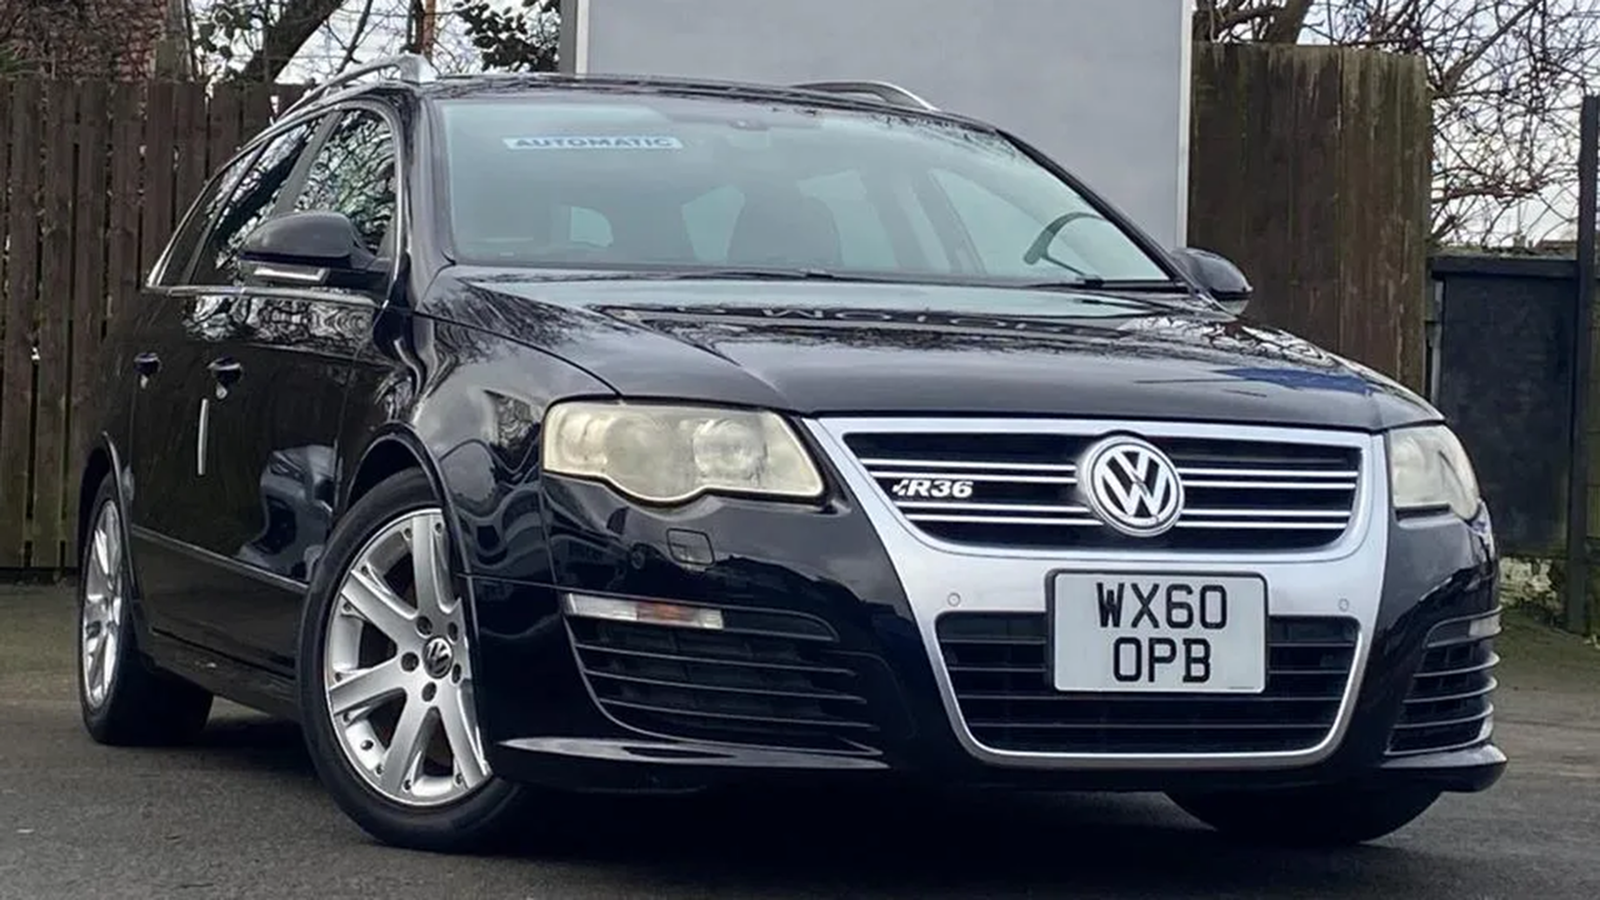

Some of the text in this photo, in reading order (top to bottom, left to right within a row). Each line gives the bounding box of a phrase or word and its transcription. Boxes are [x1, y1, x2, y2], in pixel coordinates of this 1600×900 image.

[514, 138, 673, 148] AUTOMATIC
[905, 479, 974, 498] R36
[1092, 444, 1178, 525] VW
[1096, 582, 1228, 630] WX60
[1113, 636, 1211, 683] OPB
